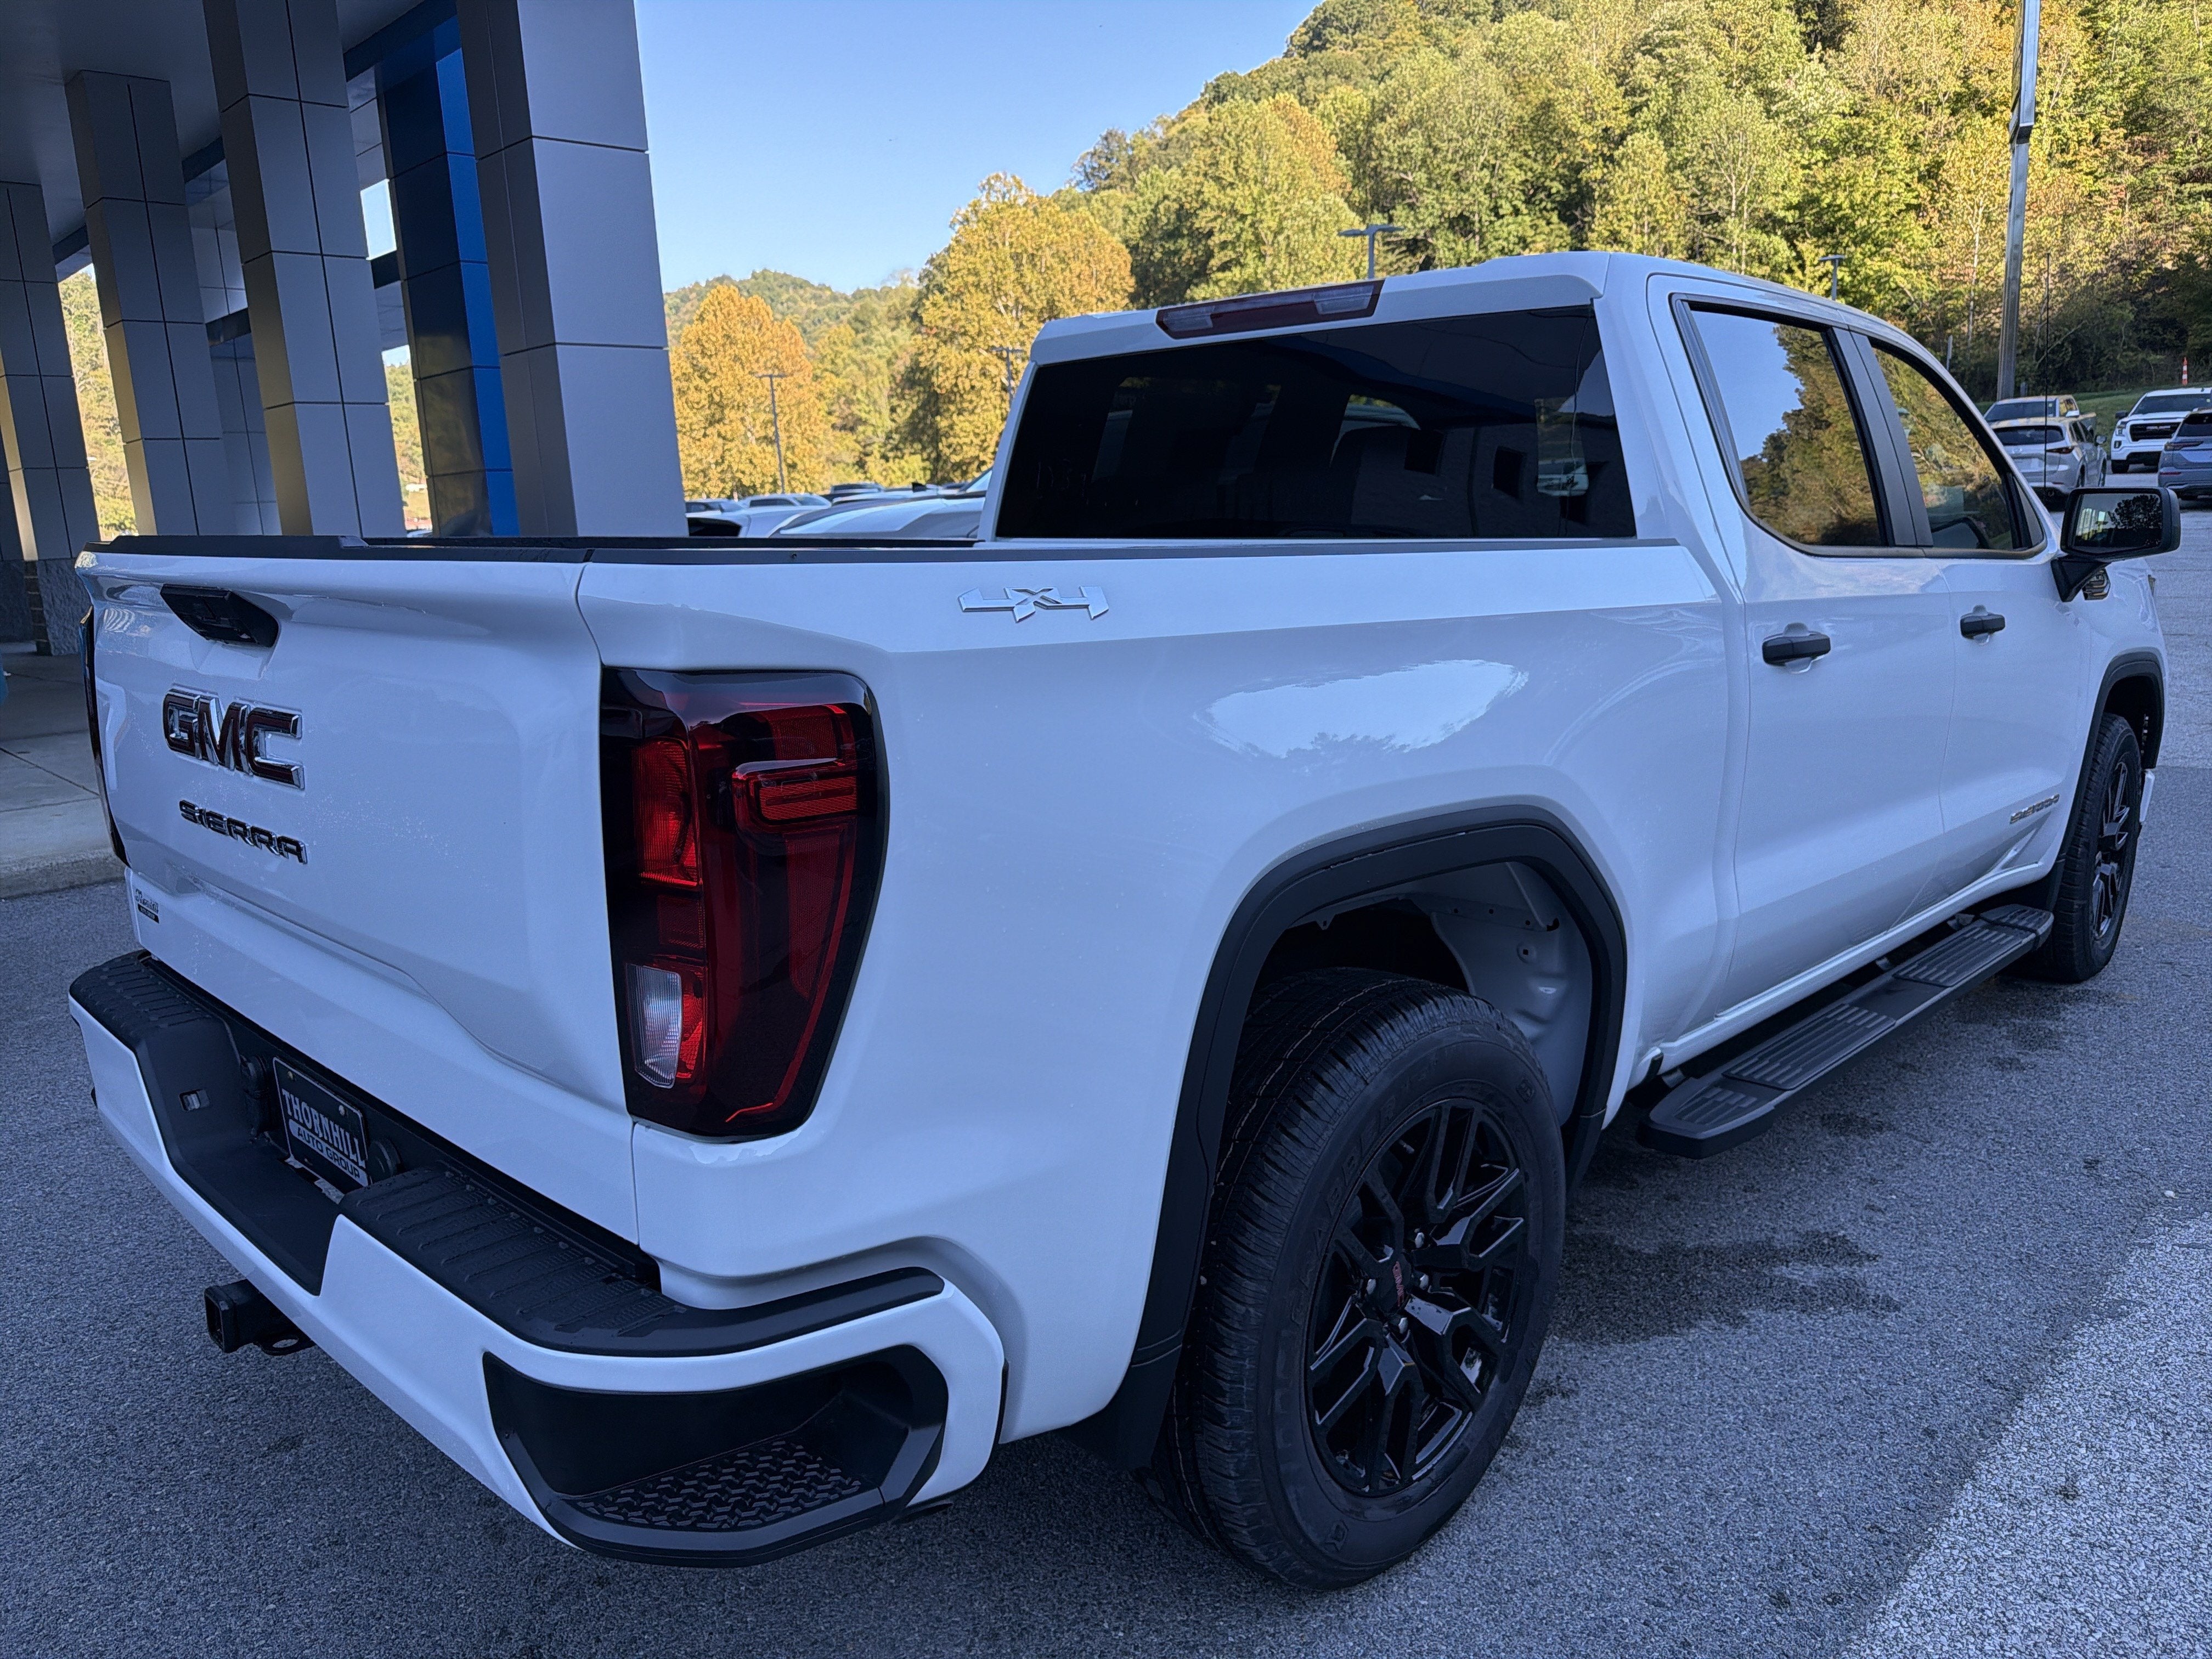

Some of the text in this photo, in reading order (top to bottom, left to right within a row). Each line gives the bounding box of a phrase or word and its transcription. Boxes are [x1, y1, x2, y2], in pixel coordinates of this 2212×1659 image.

[163, 688, 306, 790] GMC
[179, 799, 308, 864] SIERRA
[281, 1088, 366, 1169] THORNHILL
[297, 1126, 361, 1179] AUTO GROUP
